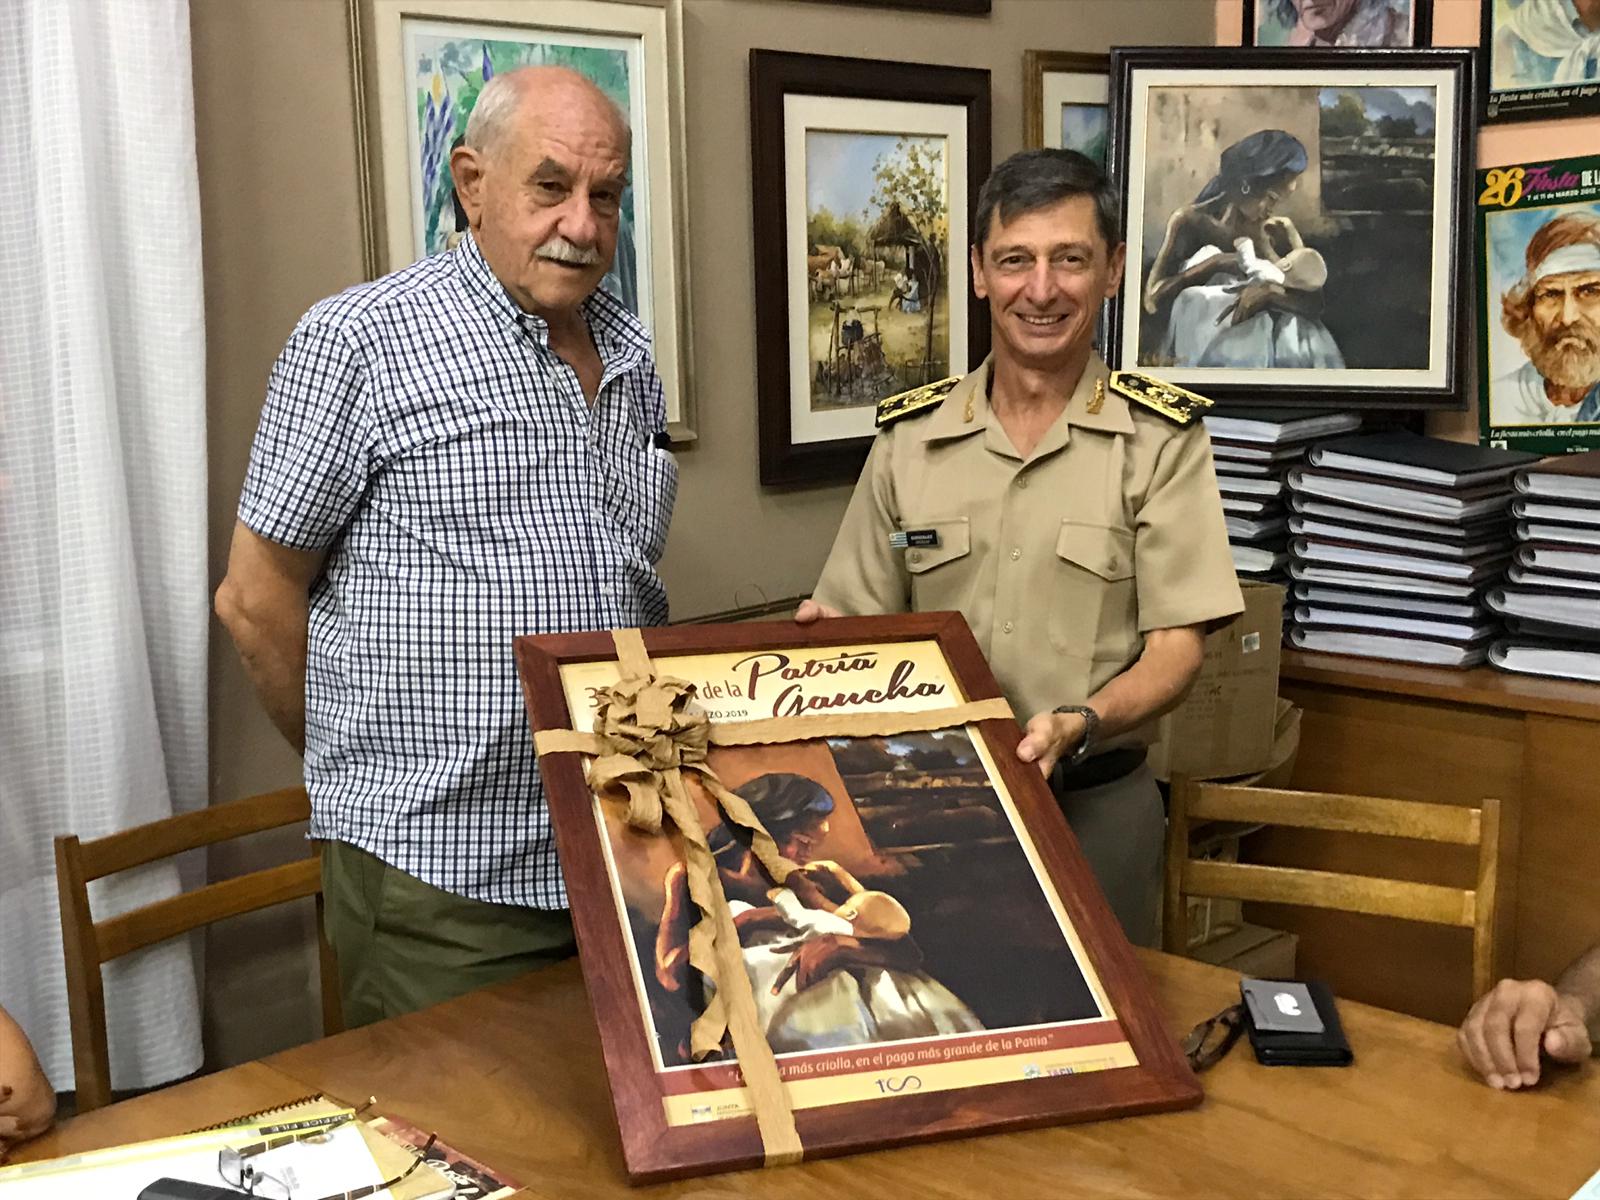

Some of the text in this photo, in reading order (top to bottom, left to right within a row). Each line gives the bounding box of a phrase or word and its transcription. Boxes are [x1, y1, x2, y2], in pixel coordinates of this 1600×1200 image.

[1478, 167, 1525, 206] 26
[1581, 170, 1593, 186] DE
[724, 680, 743, 698] la
[731, 651, 880, 700] Patria
[773, 659, 946, 718] Gaucha
[702, 682, 723, 699] de
[706, 709, 749, 719] ZO.2019
[789, 1062, 814, 1075] más
[816, 1057, 855, 1071] criolla,
[856, 1056, 870, 1067] en
[873, 1052, 883, 1064] el
[886, 1052, 915, 1066] pago
[917, 1047, 941, 1059] más
[944, 1042, 983, 1059] grande
[985, 1040, 999, 1052] de
[1001, 1038, 1012, 1050] la
[271, 1123, 298, 1132] FILE
